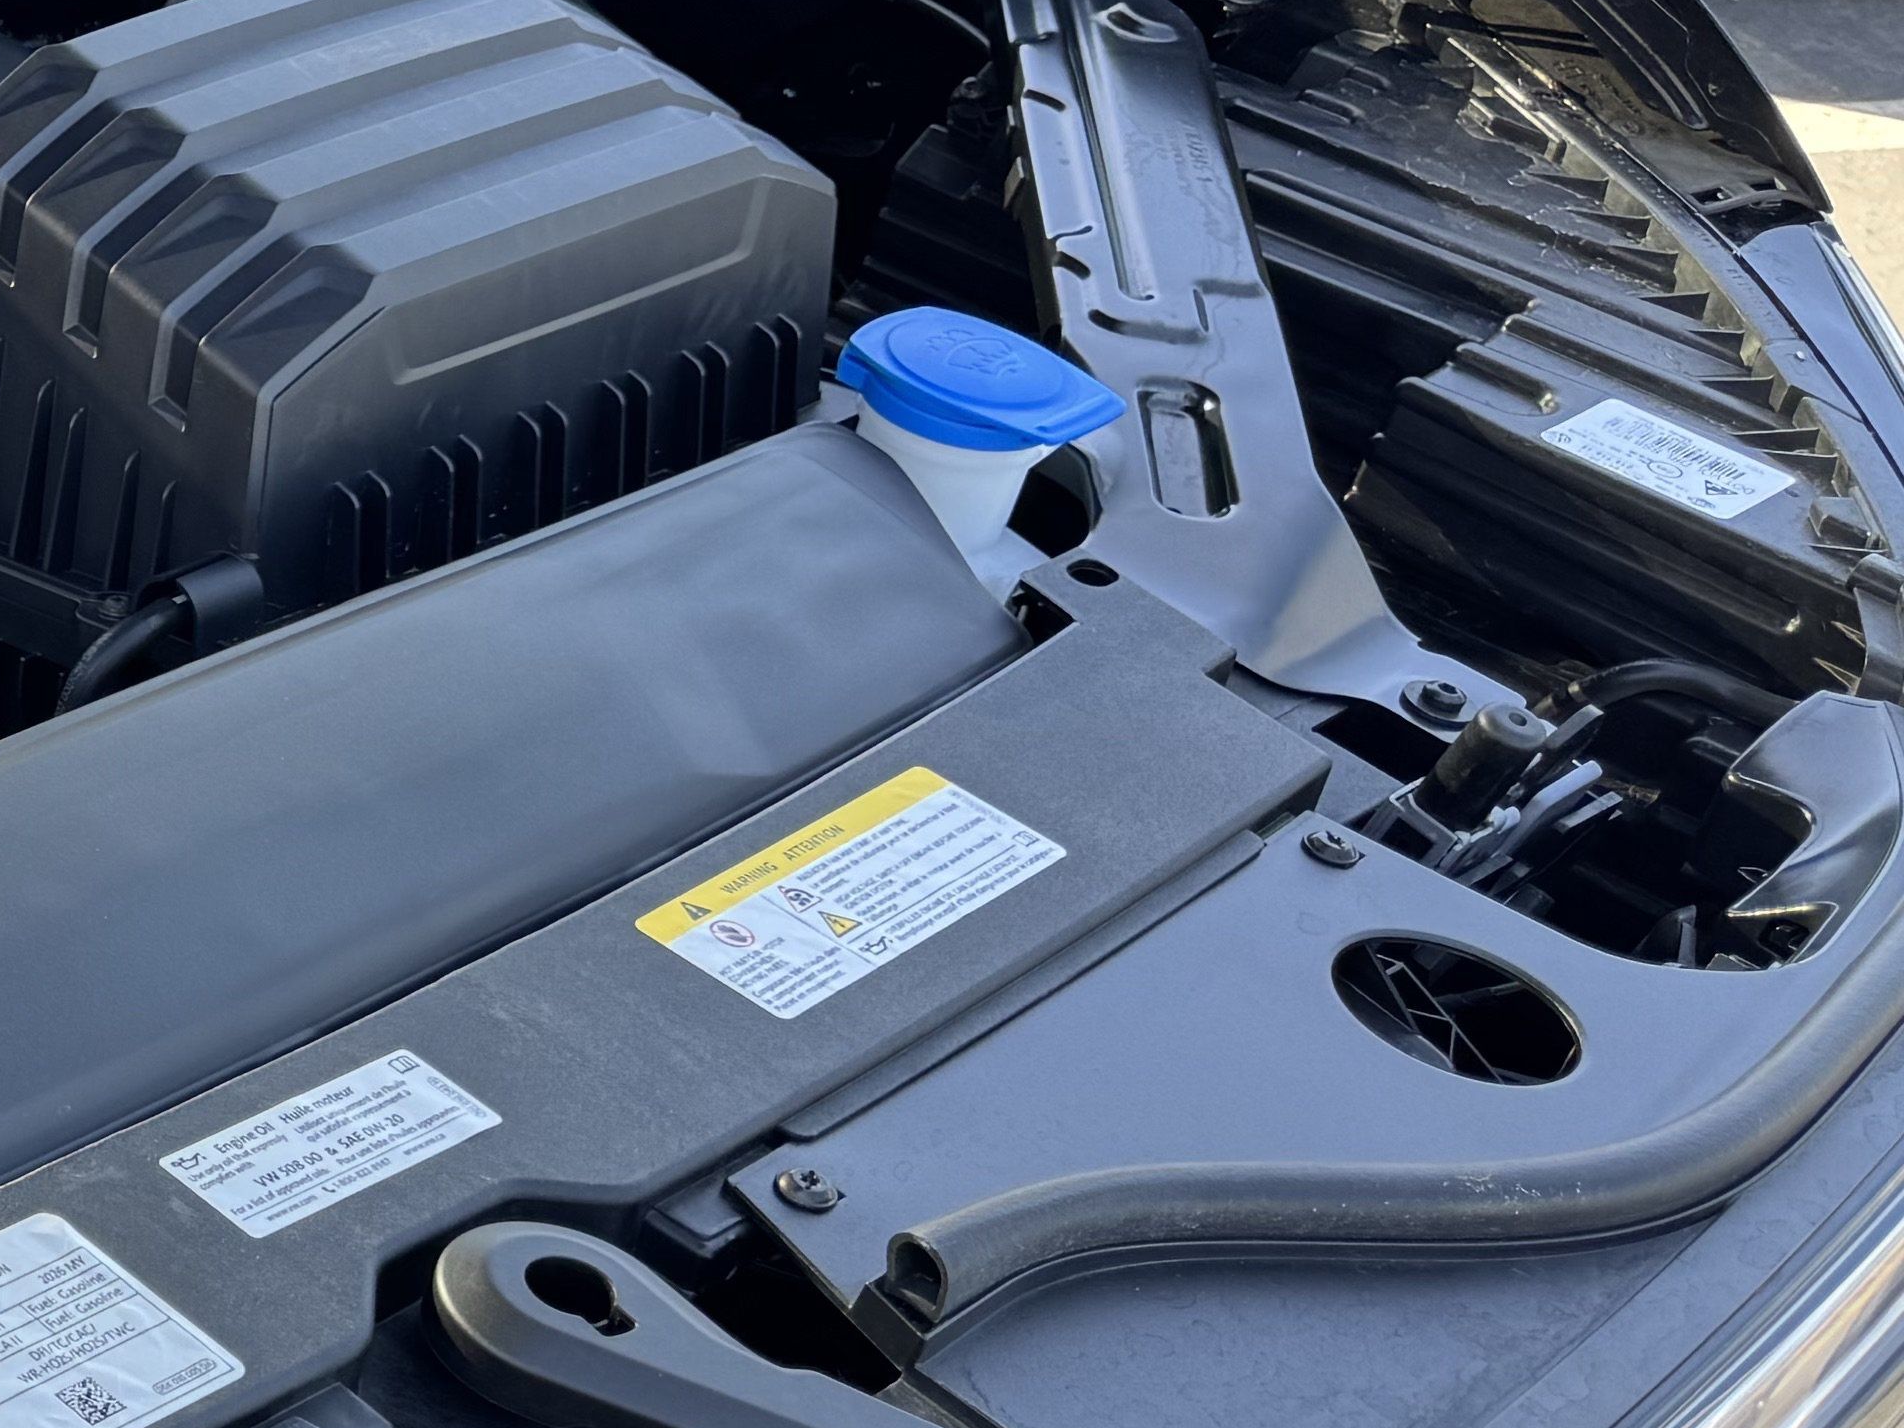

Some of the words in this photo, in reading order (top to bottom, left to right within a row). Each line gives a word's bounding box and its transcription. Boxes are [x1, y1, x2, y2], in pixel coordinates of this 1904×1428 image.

[719, 861, 779, 895] WARNING
[780, 824, 846, 861] ATTENTION
[276, 1103, 315, 1124] Huile
[308, 1085, 356, 1110] moteur
[212, 1129, 261, 1156] Engine
[250, 1121, 276, 1136] Oil
[252, 1170, 283, 1188] VW
[275, 1159, 307, 1177] 508
[299, 1150, 325, 1166] 00
[322, 1145, 340, 1156] &
[334, 1131, 367, 1149] SAE
[358, 1112, 407, 1138] 0W-20
[35, 1265, 69, 1284] 2026
[61, 1254, 89, 1272] MY
[25, 1294, 59, 1314] Fuel:
[53, 1270, 109, 1301] Gasoline
[42, 1308, 77, 1329] Fuel:
[70, 1284, 126, 1315] Gasoline
